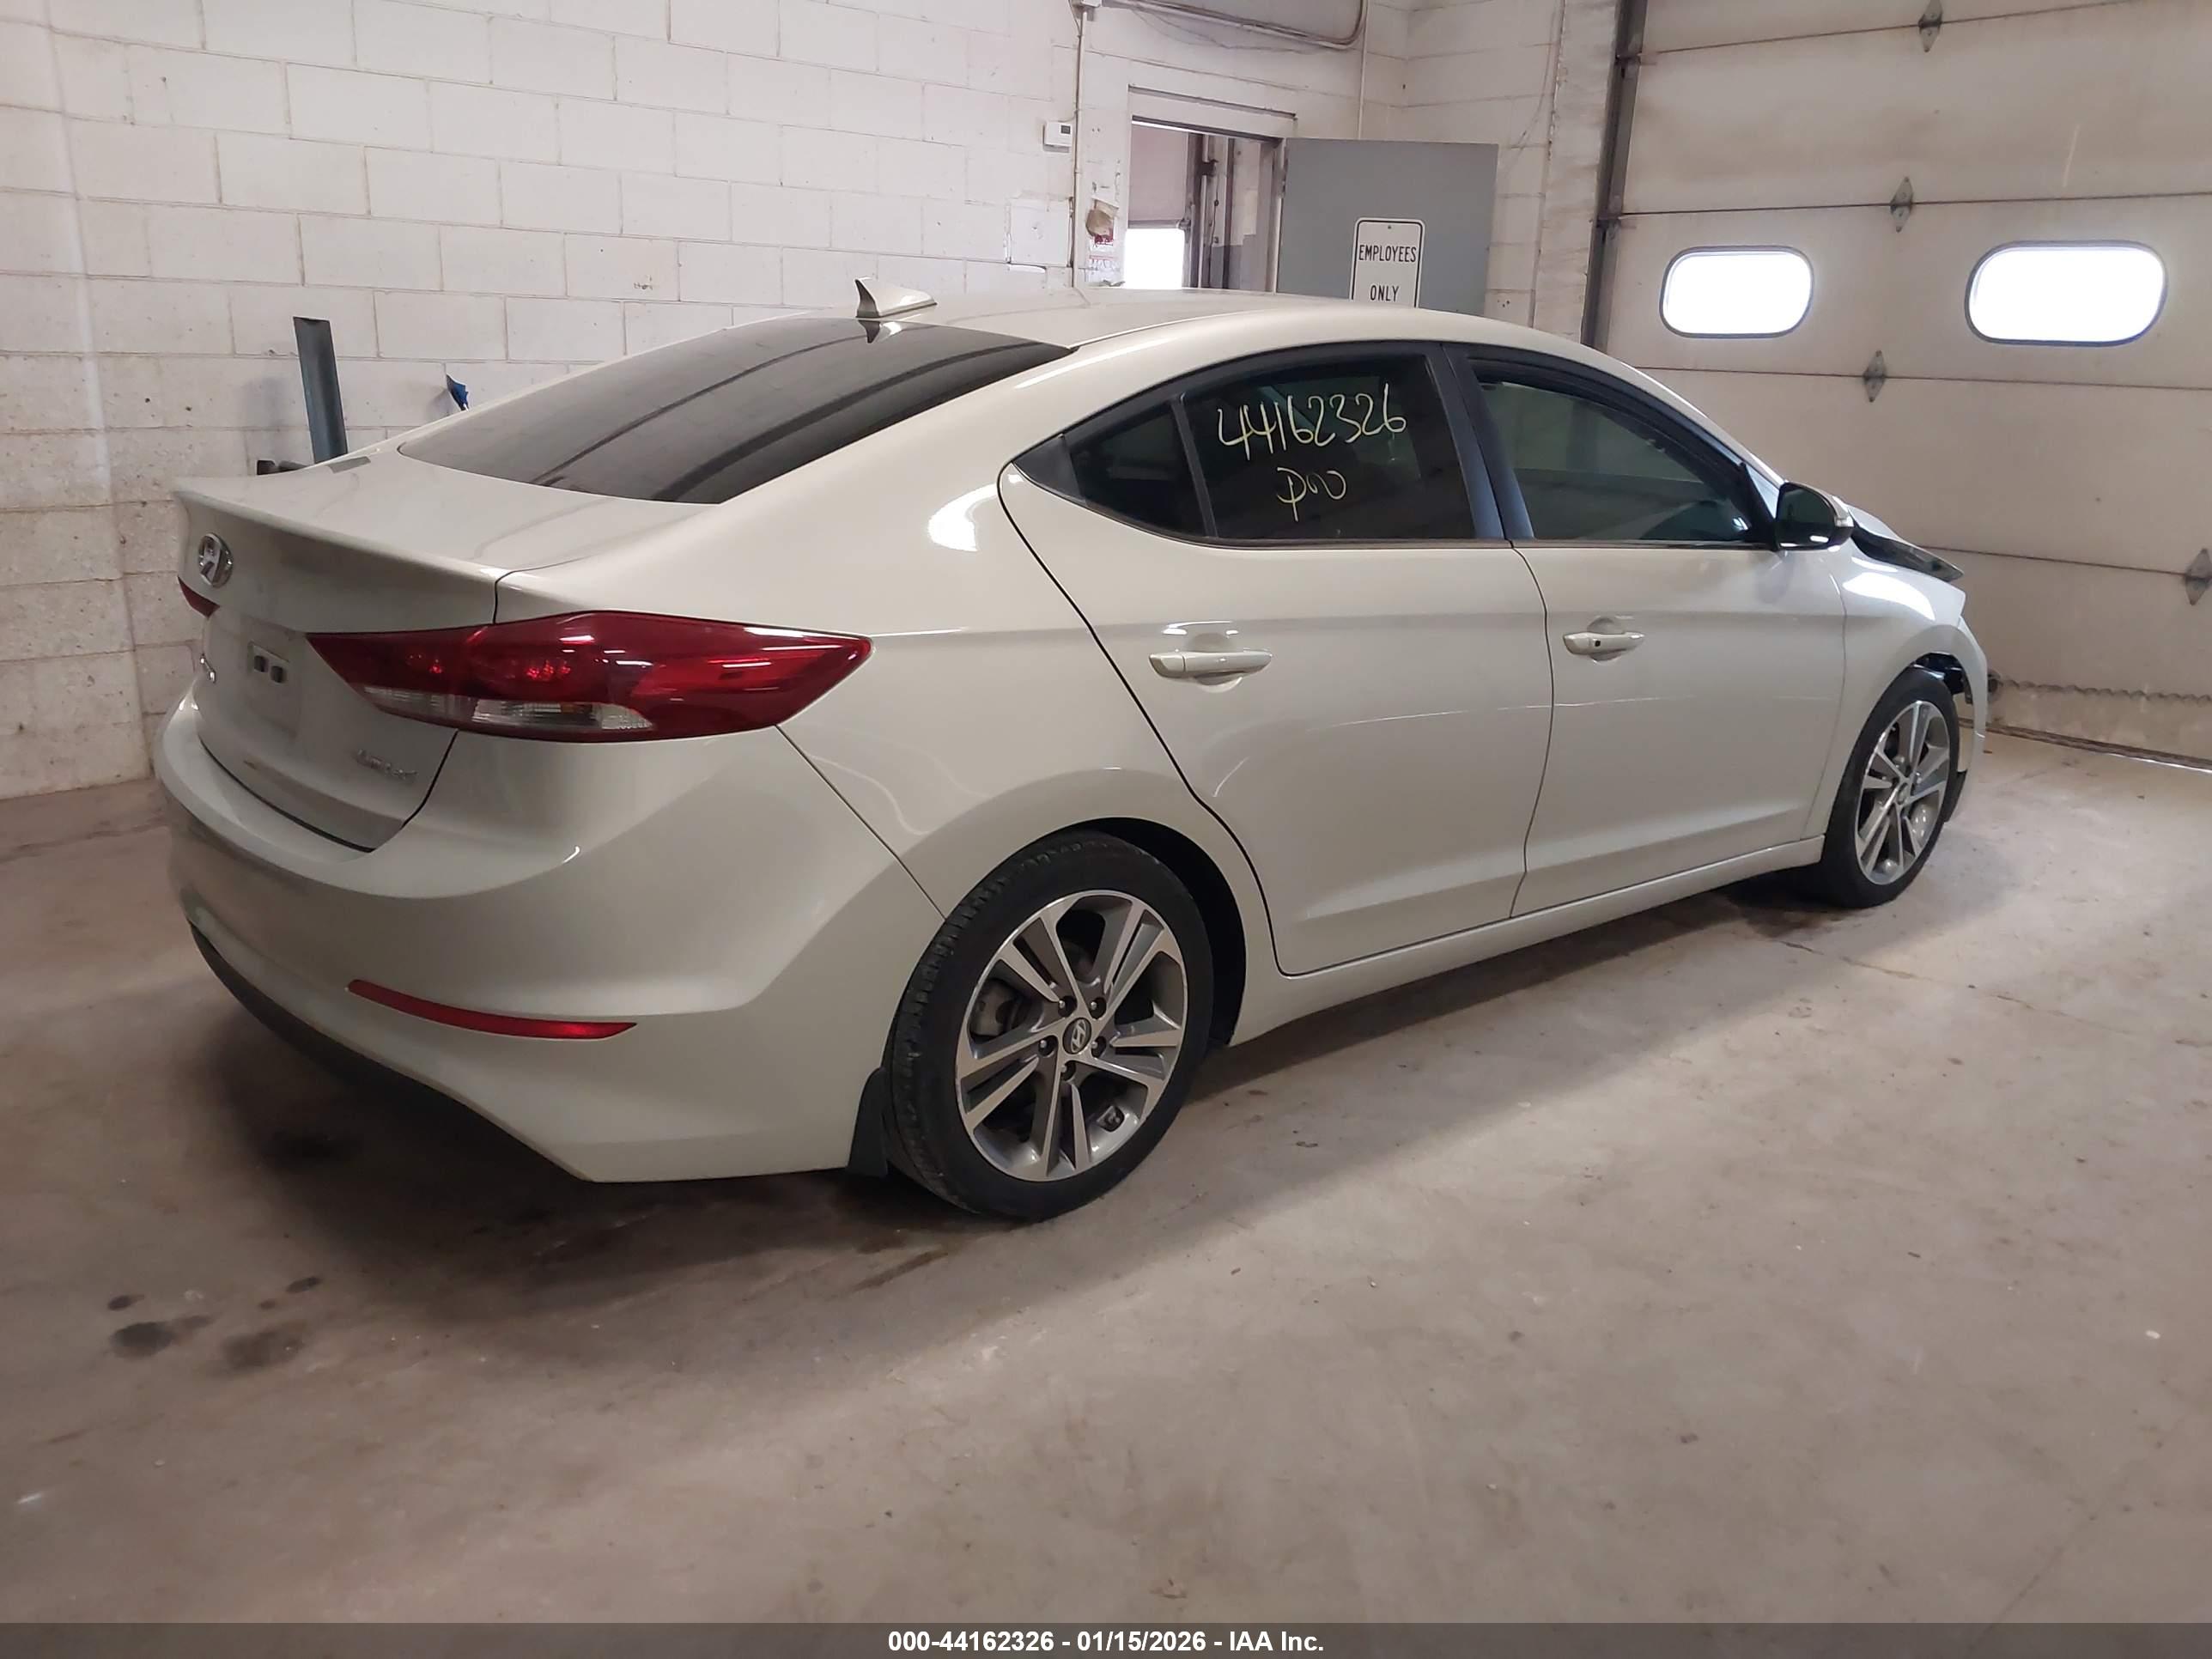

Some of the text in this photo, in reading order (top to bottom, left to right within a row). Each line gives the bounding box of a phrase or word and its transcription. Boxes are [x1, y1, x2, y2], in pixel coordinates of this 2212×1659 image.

[1358, 244, 1417, 263] EMPLOYEES
[1370, 284, 1400, 302] ONLY
[1218, 383, 1407, 460] 44162326
